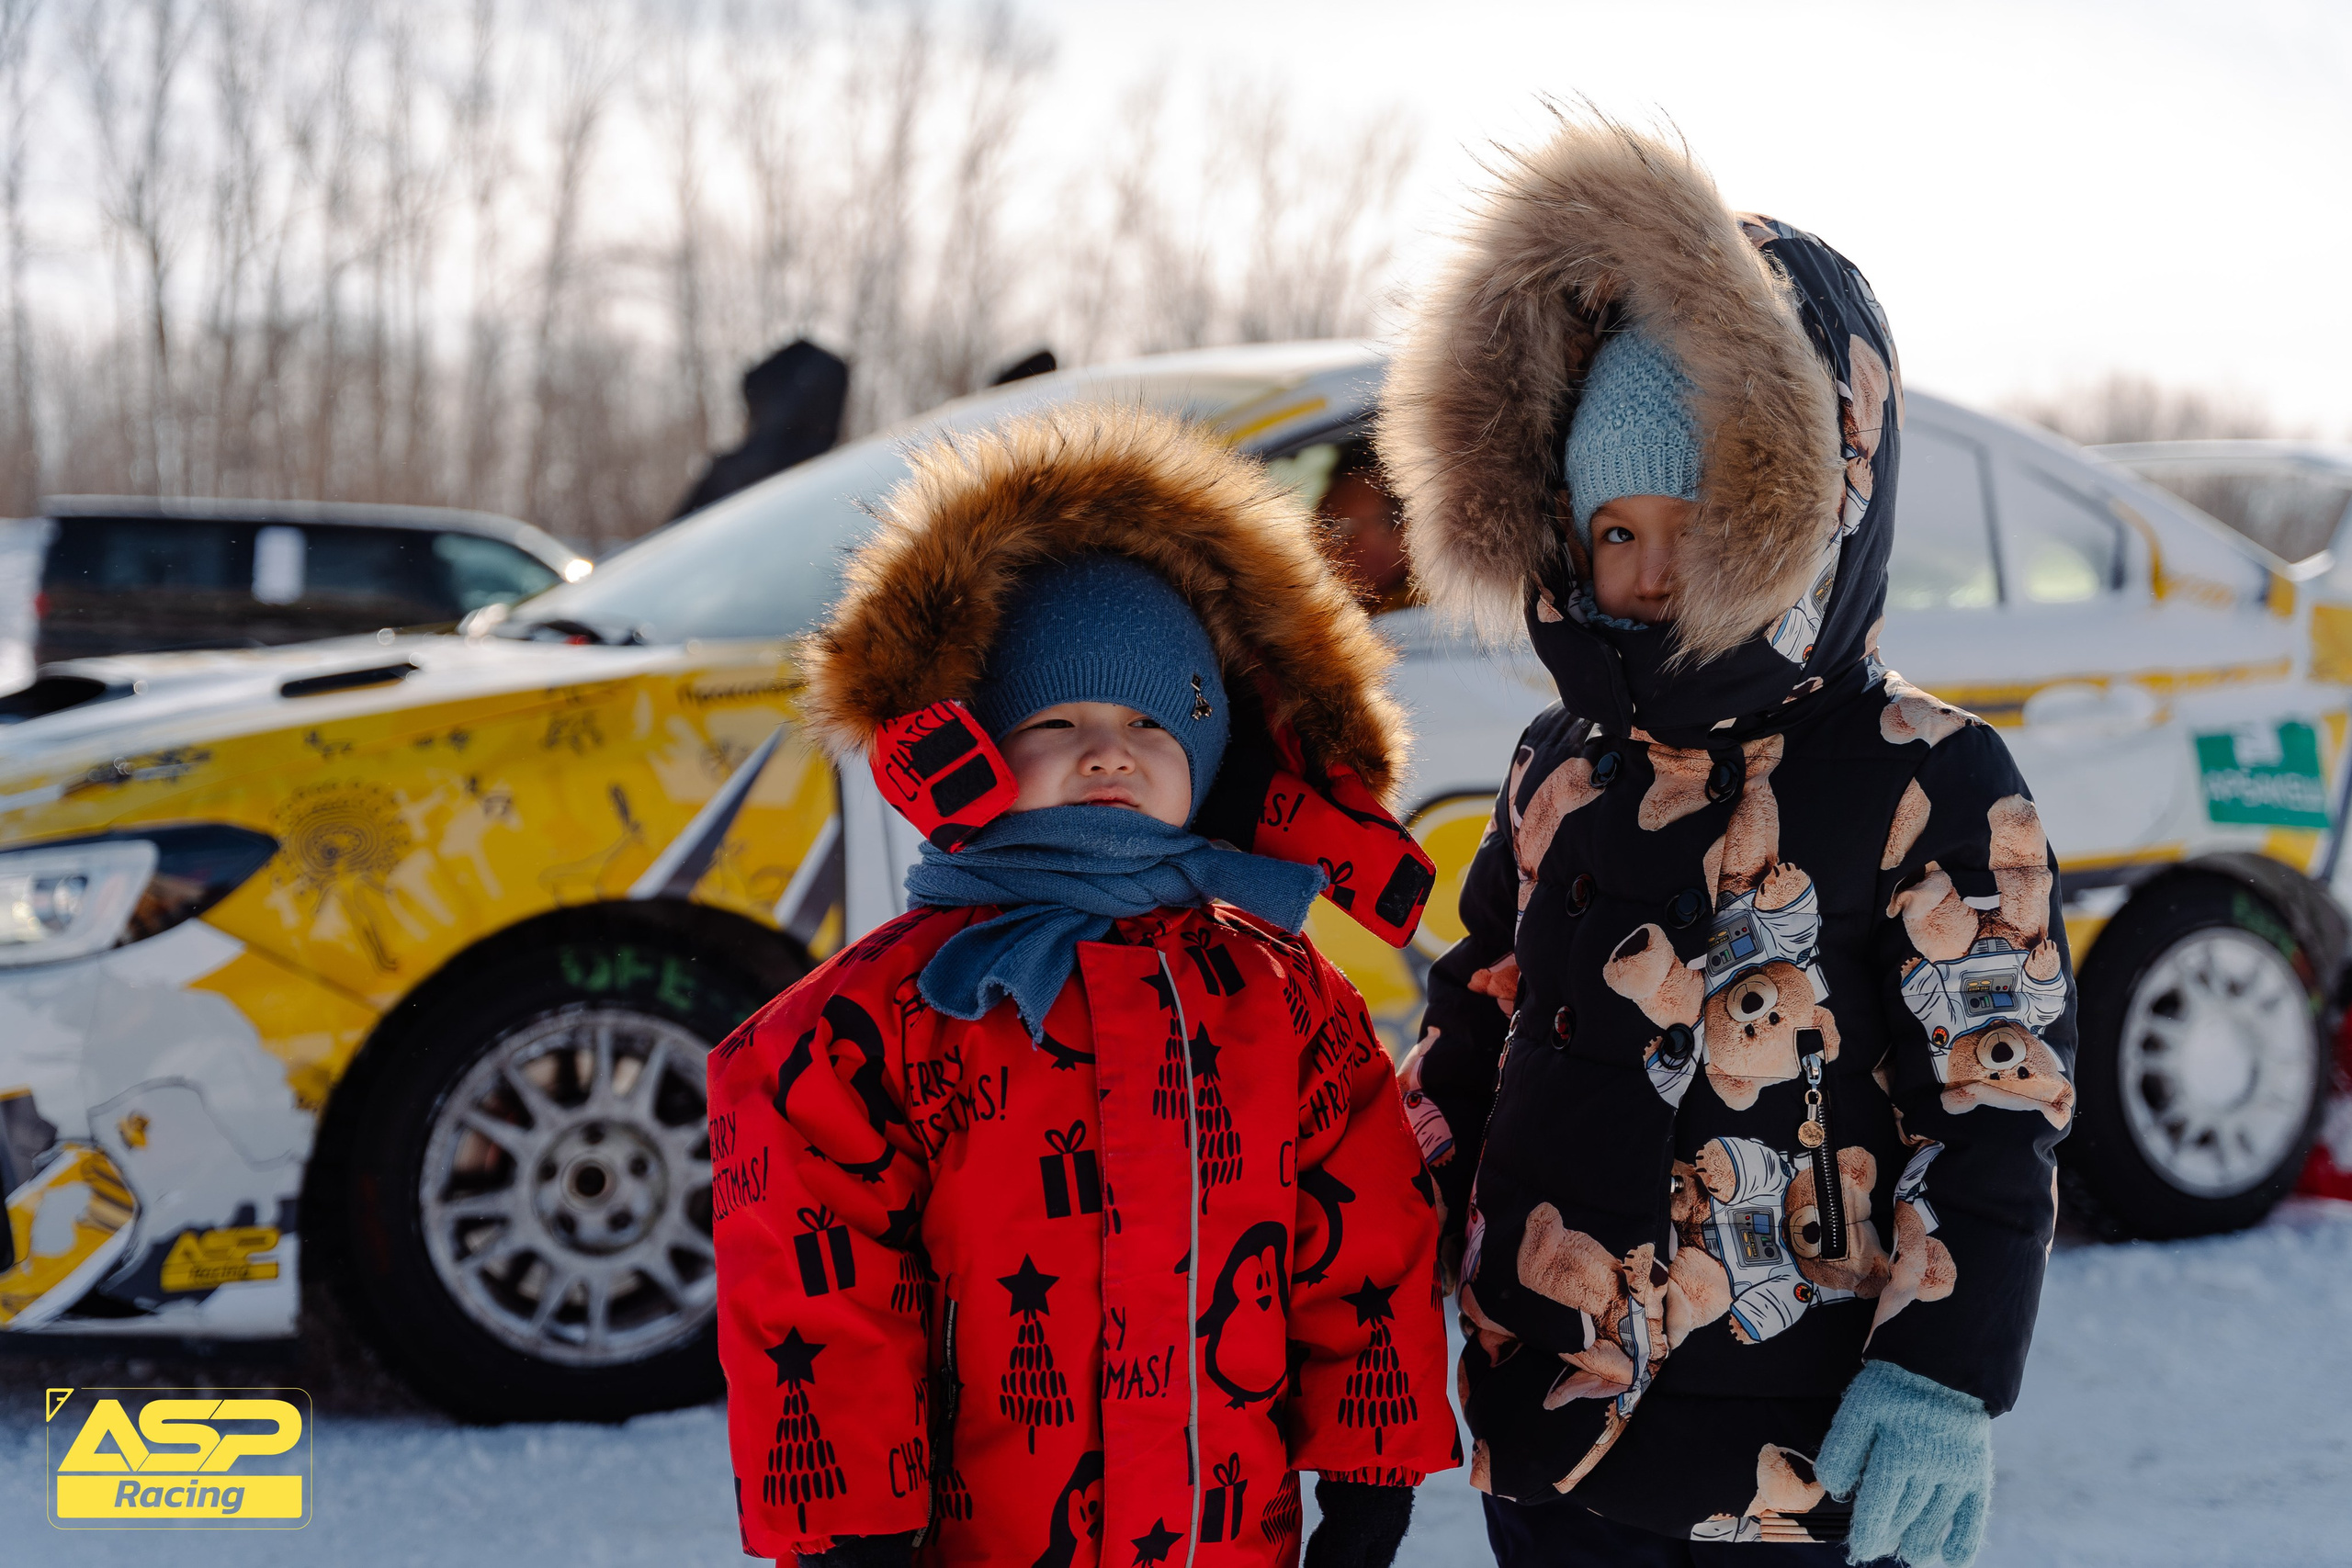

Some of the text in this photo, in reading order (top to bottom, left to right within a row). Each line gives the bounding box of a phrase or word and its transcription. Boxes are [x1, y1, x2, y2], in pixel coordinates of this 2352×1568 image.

[907, 1044, 964, 1107] ERRY
[709, 1111, 736, 1164] ERRY
[1102, 1345, 1175, 1400] MAS!
